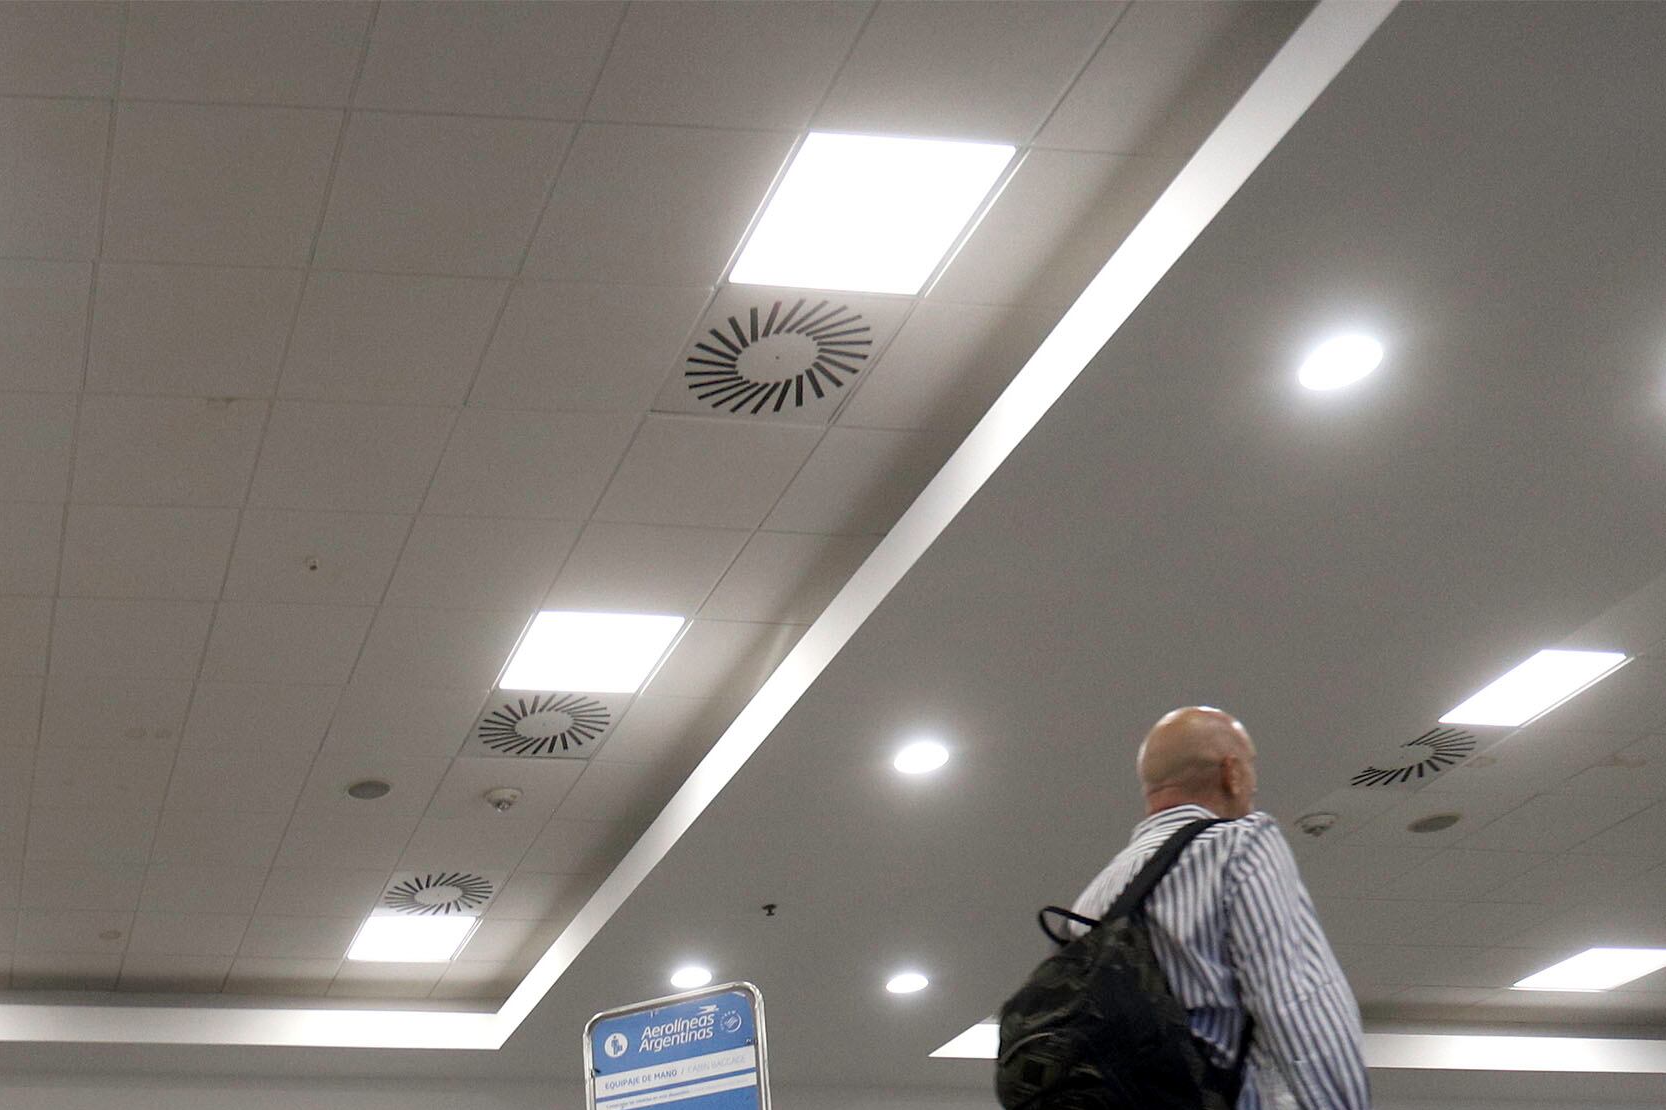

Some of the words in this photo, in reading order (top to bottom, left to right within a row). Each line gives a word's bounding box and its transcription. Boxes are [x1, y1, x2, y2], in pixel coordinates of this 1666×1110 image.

[639, 1026, 714, 1052] Argentinas
[641, 1014, 715, 1040] Aerolíneas
[605, 1077, 639, 1090] EQUIPAJE
[641, 1074, 652, 1083] DE
[654, 1070, 678, 1080] MANO
